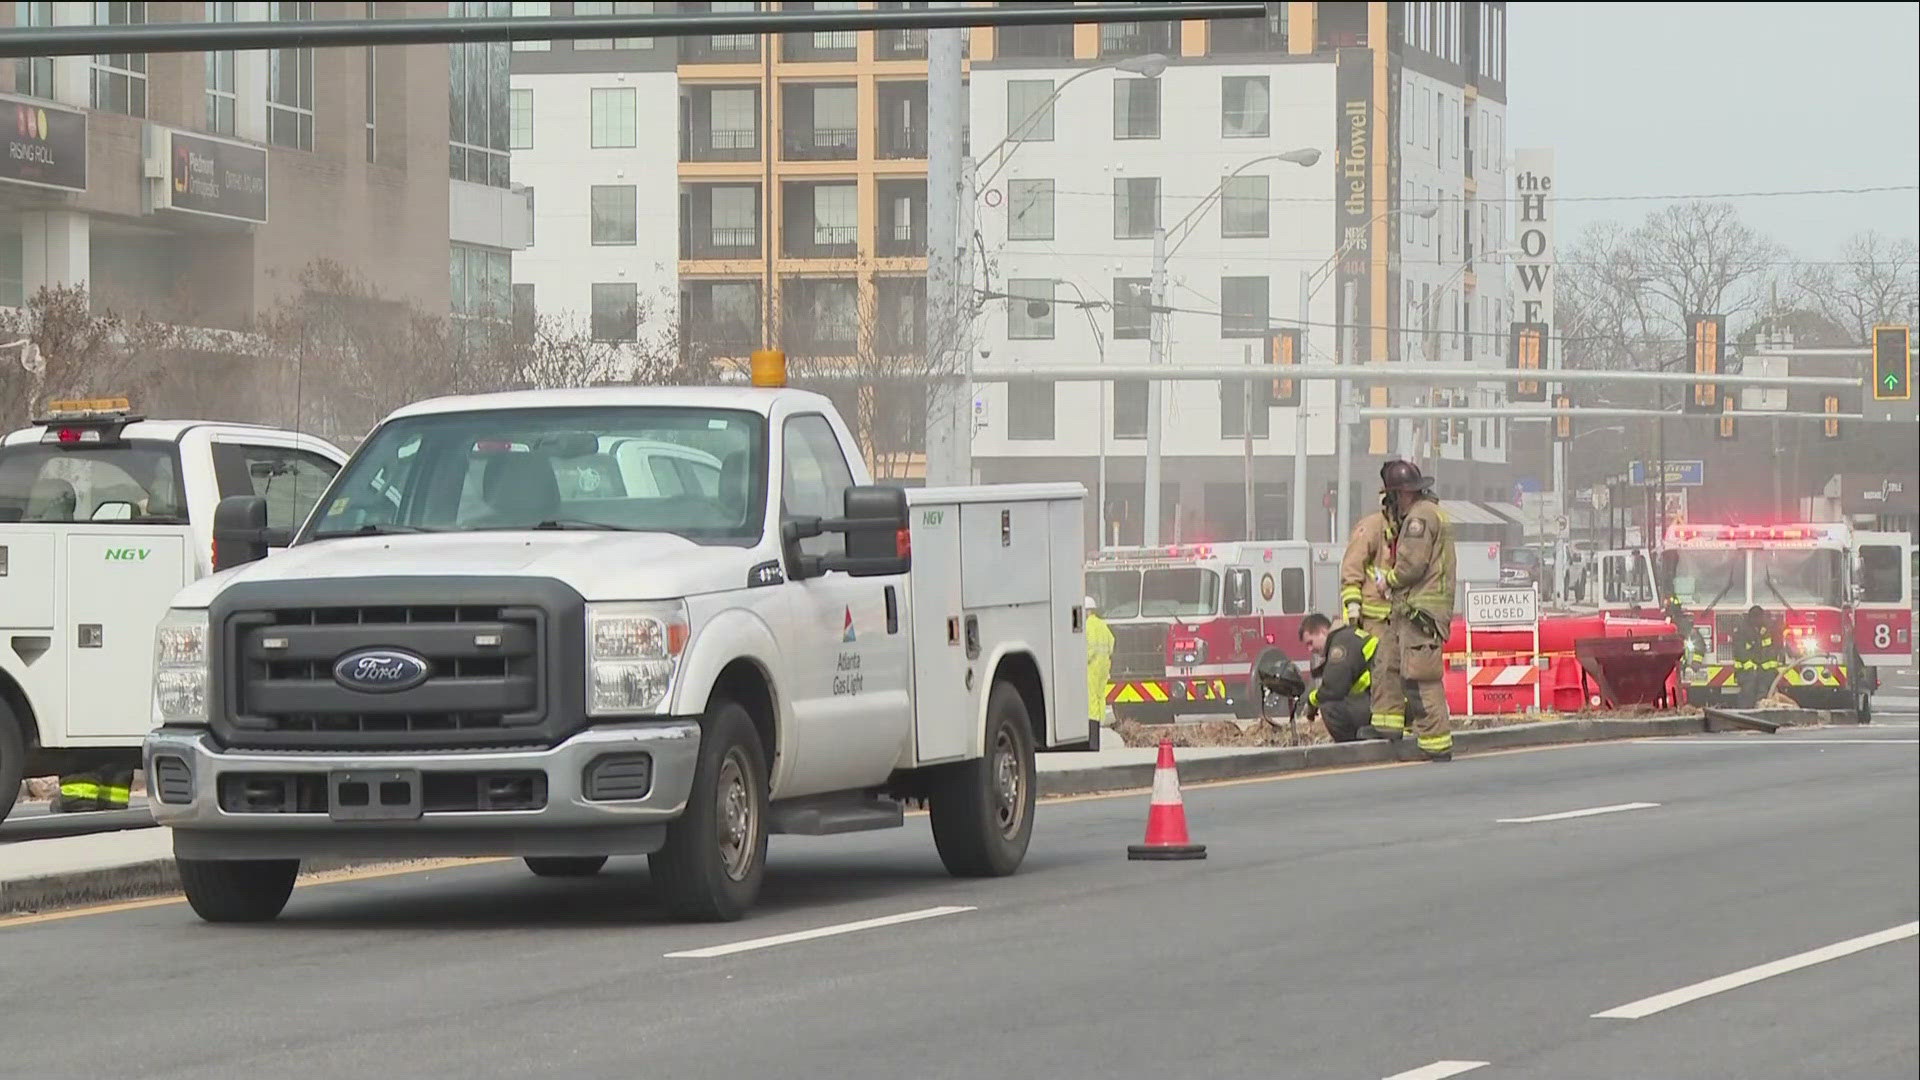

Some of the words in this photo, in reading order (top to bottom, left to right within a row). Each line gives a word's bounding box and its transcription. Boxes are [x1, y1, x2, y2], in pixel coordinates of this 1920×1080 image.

[1345, 100, 1366, 179] Howell
[10, 141, 34, 160] RISING
[35, 145, 54, 165] ROLL
[1517, 172, 1551, 190] the
[1345, 180, 1365, 215] the
[922, 511, 944, 525] NGV
[105, 548, 151, 561] NGV
[1473, 594, 1530, 606] SIDEWALK
[1479, 608, 1524, 619] CLOSED
[1874, 623, 1891, 650] 8
[354, 658, 402, 680] Ford
[837, 652, 861, 671] Atlanta
[833, 676, 846, 695] Gas
[847, 672, 863, 696] Light
